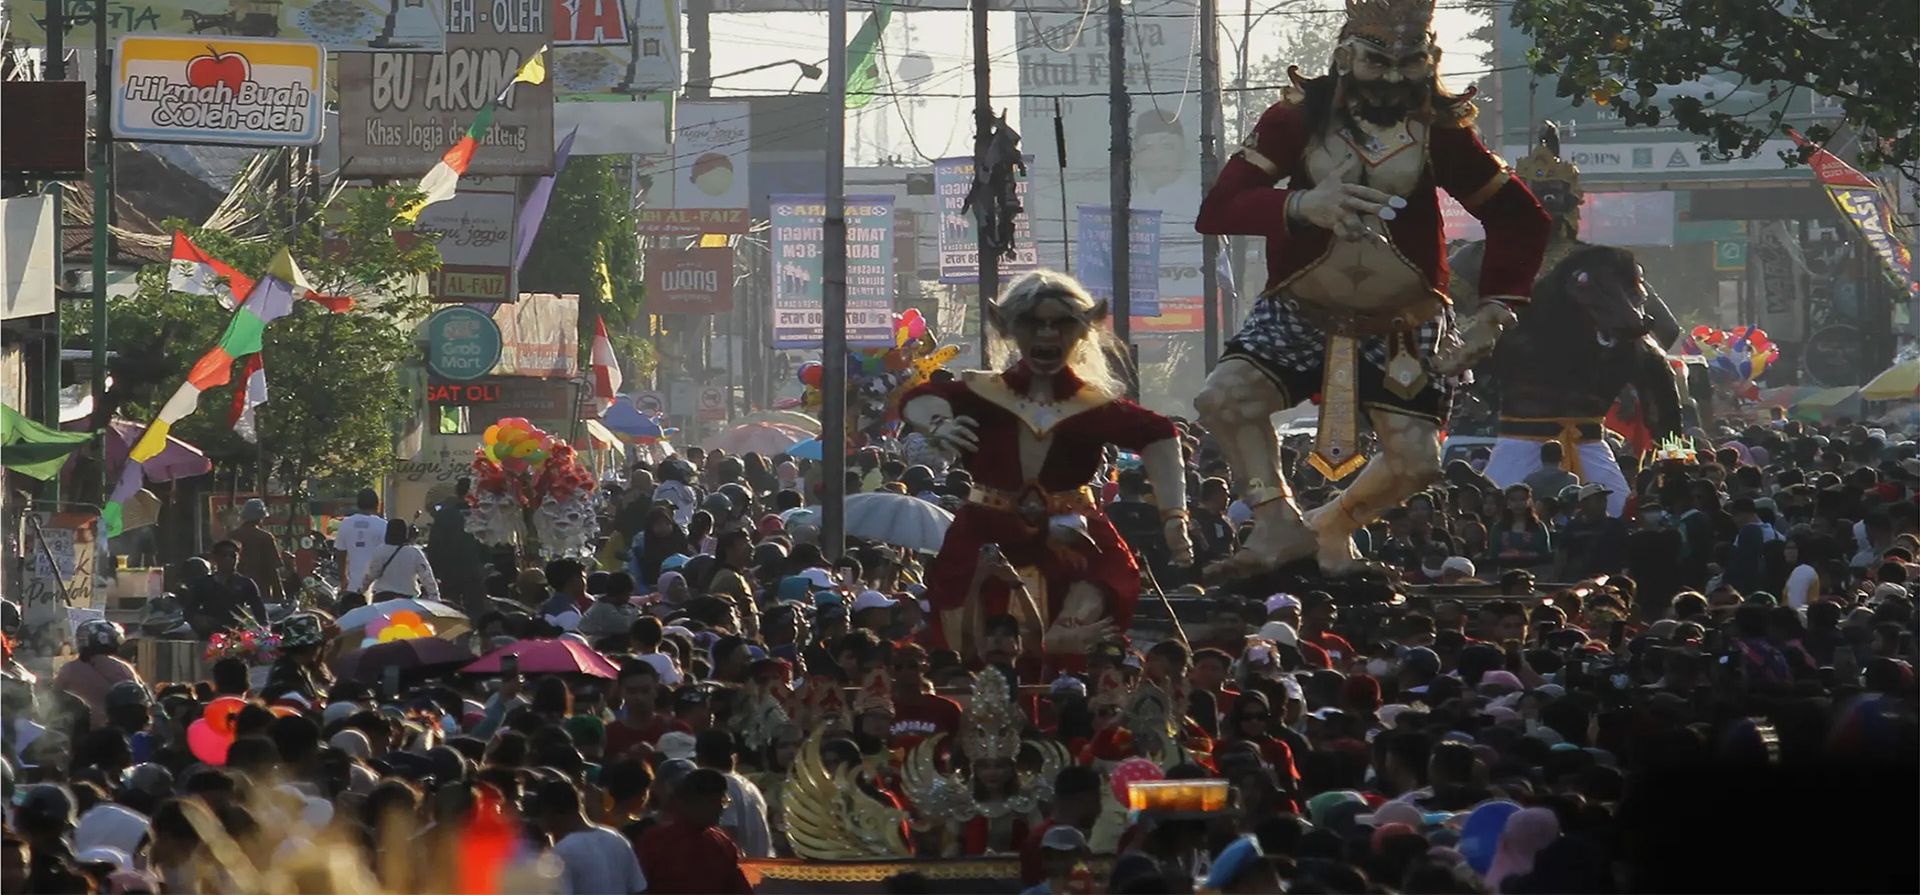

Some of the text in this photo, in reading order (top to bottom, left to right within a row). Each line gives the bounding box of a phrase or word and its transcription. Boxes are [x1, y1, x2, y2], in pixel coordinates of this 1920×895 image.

[493, 0, 543, 33] OLEH
[126, 76, 311, 107] Hikmah Buah
[372, 53, 413, 111] BU
[365, 119, 402, 146] Khas
[406, 118, 443, 151] Jogja
[447, 276, 504, 295] AL-FAIZ
[441, 342, 481, 356] Grab
[441, 356, 481, 369] Mart
